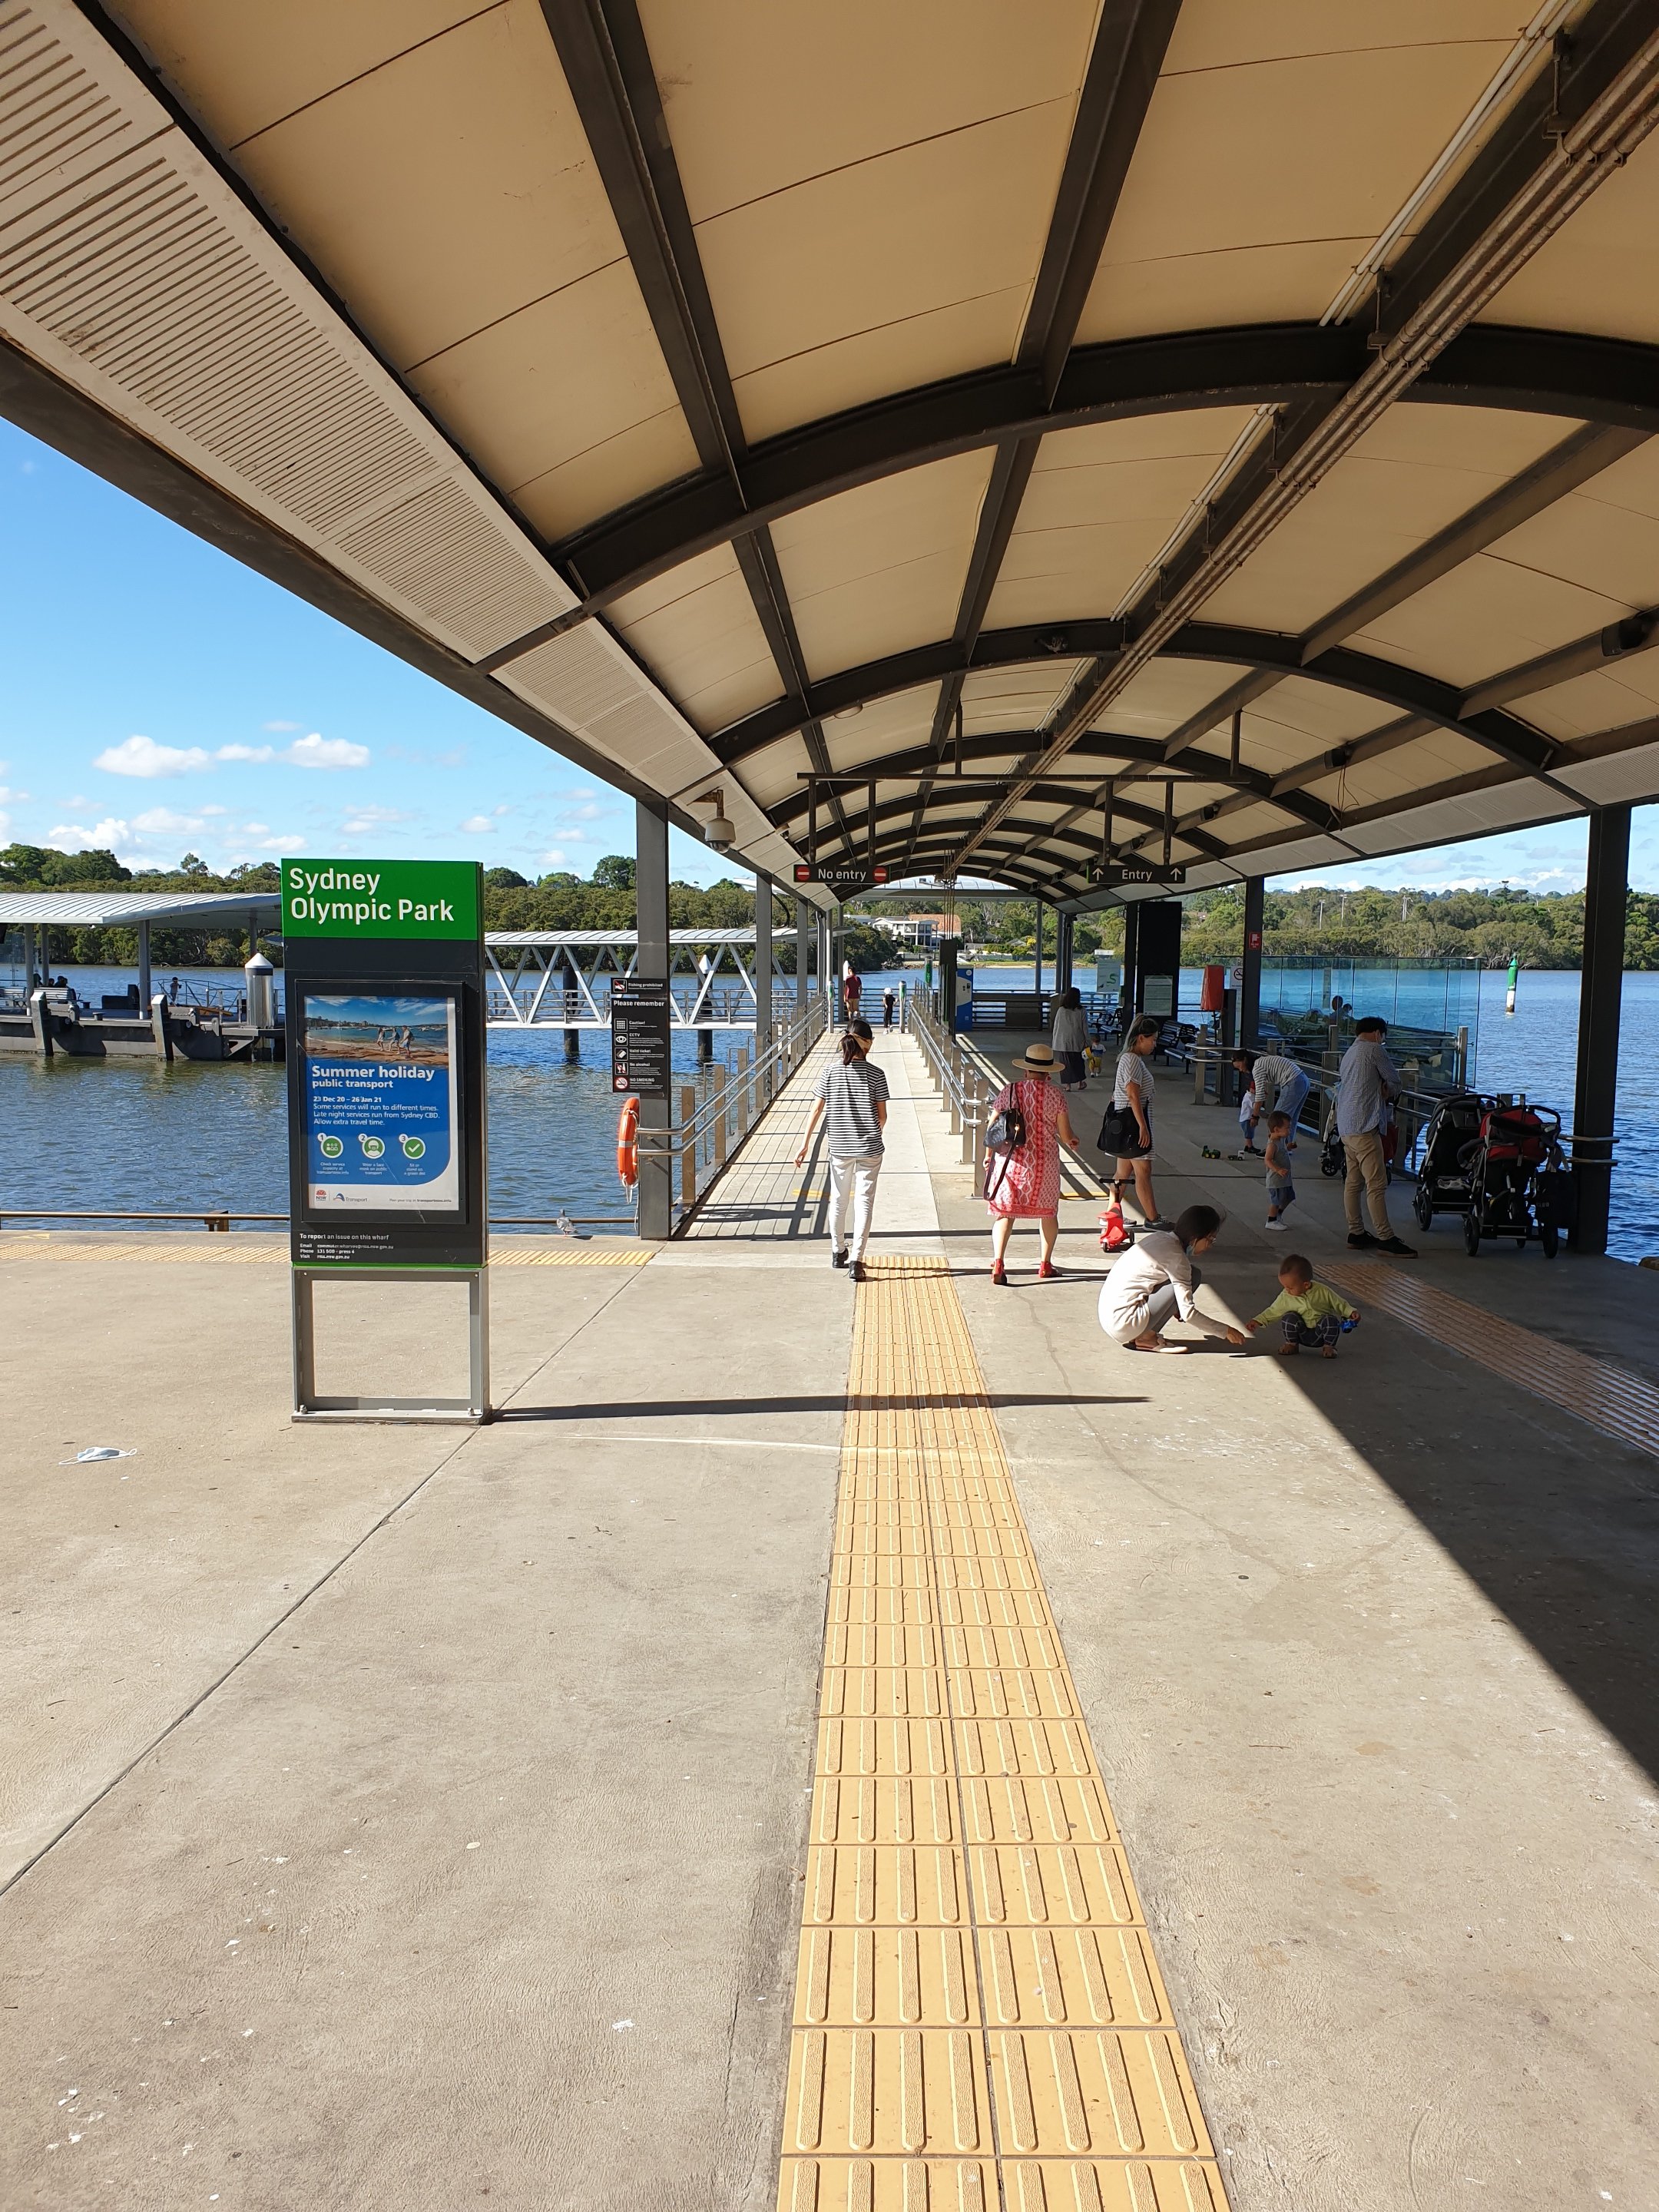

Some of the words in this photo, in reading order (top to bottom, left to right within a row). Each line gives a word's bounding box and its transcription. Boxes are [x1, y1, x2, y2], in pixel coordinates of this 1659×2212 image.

[290, 868, 380, 896] Sydney
[818, 869, 833, 879] No
[836, 870, 866, 882] entry
[1122, 869, 1153, 882] Entry
[291, 897, 392, 925] Olympic
[399, 899, 454, 922] Park
[312, 1065, 376, 1078] Summer
[379, 1066, 435, 1081] holiday
[312, 1079, 343, 1089] public
[346, 1080, 393, 1090] transport
